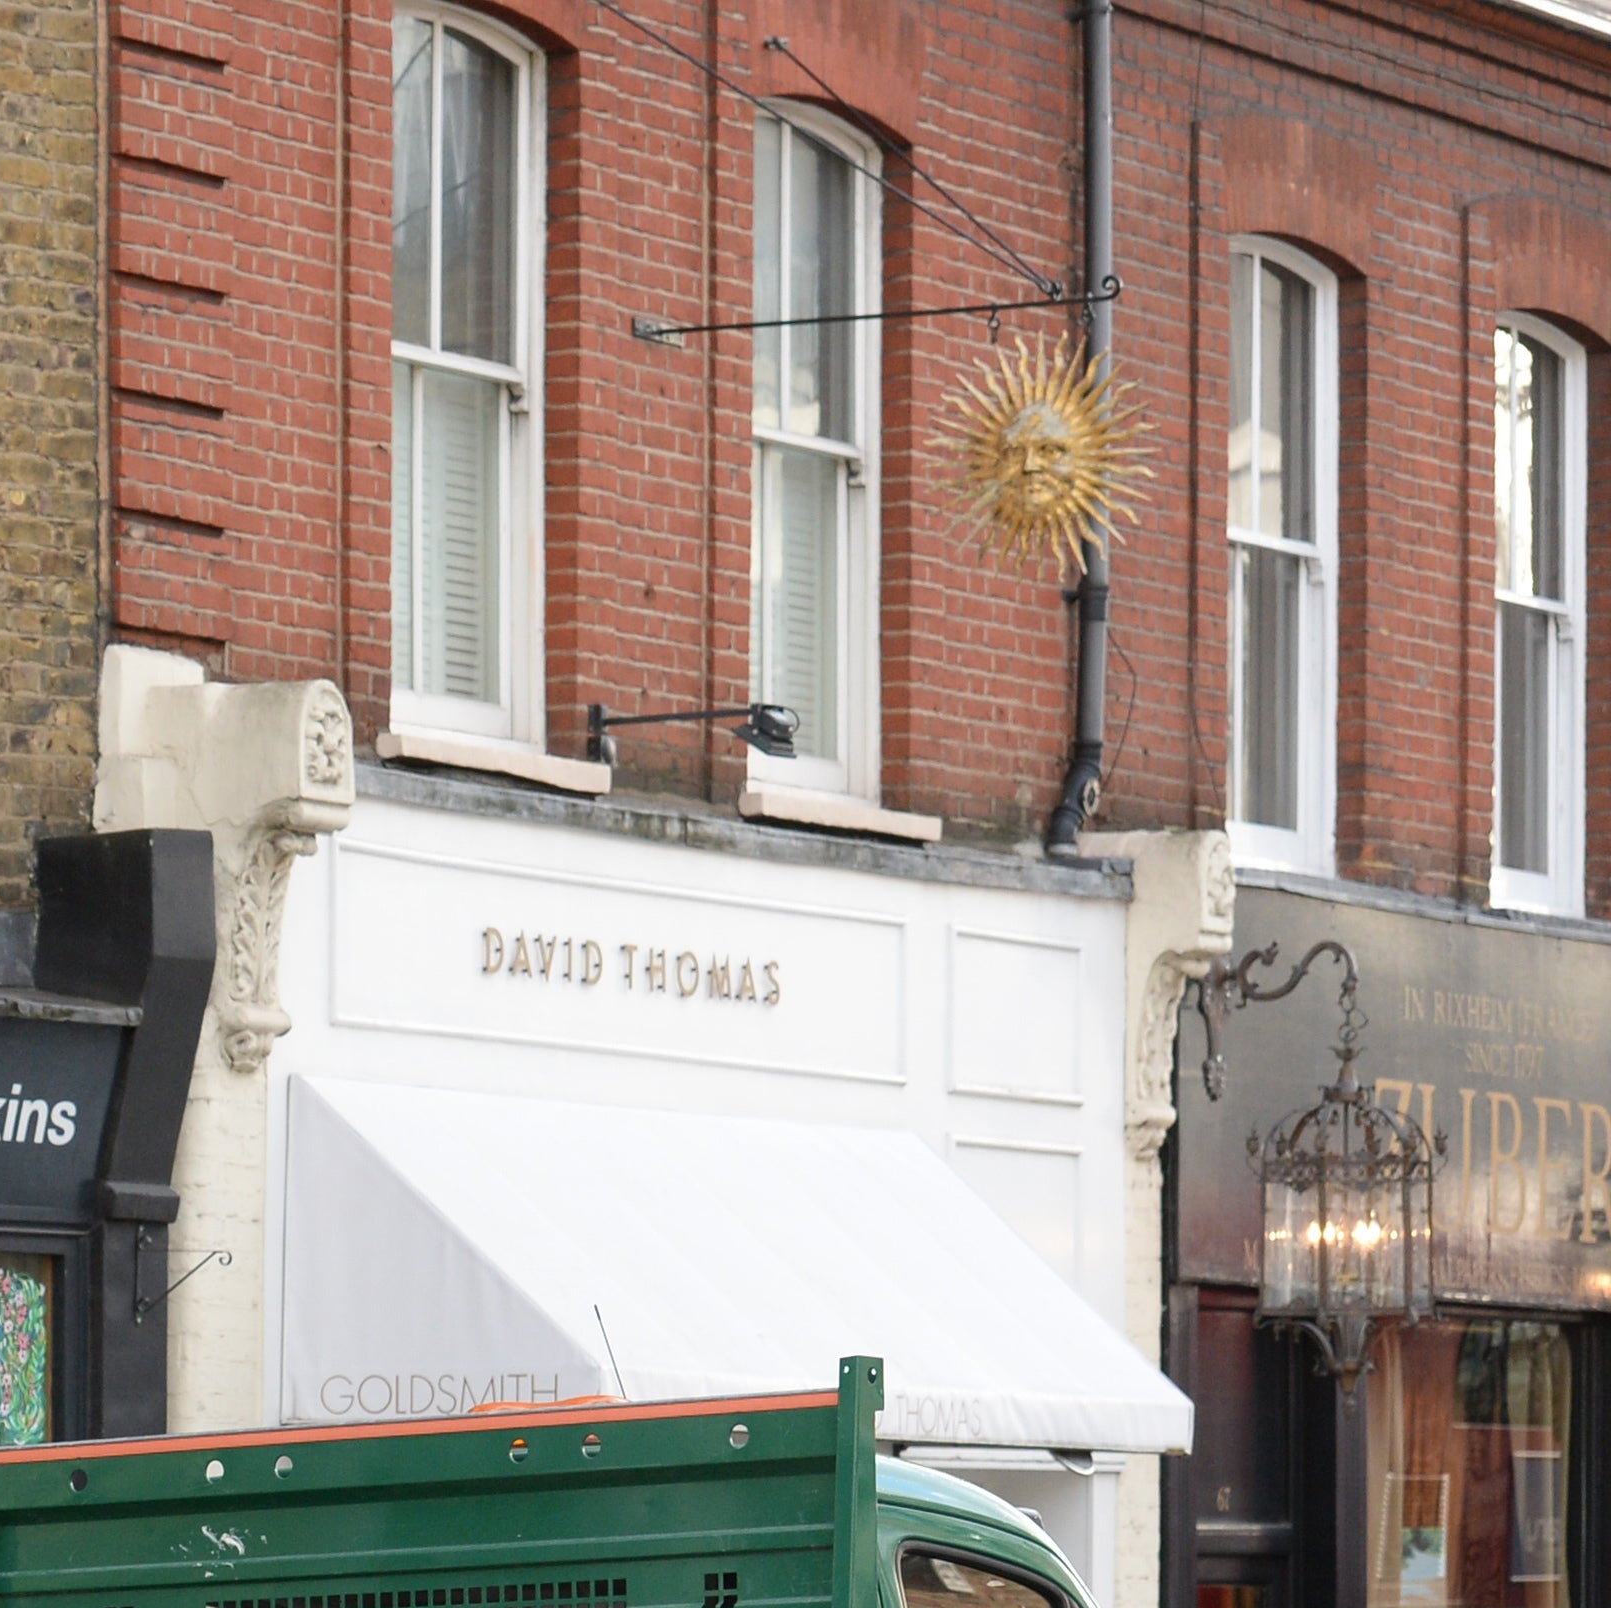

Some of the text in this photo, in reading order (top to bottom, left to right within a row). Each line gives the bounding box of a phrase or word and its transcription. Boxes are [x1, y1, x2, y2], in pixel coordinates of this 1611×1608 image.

[482, 926, 781, 1005] DAVID THOMAS
[320, 1373, 559, 1415] GOLDSMITH
[896, 1391, 983, 1437] THOMAS
